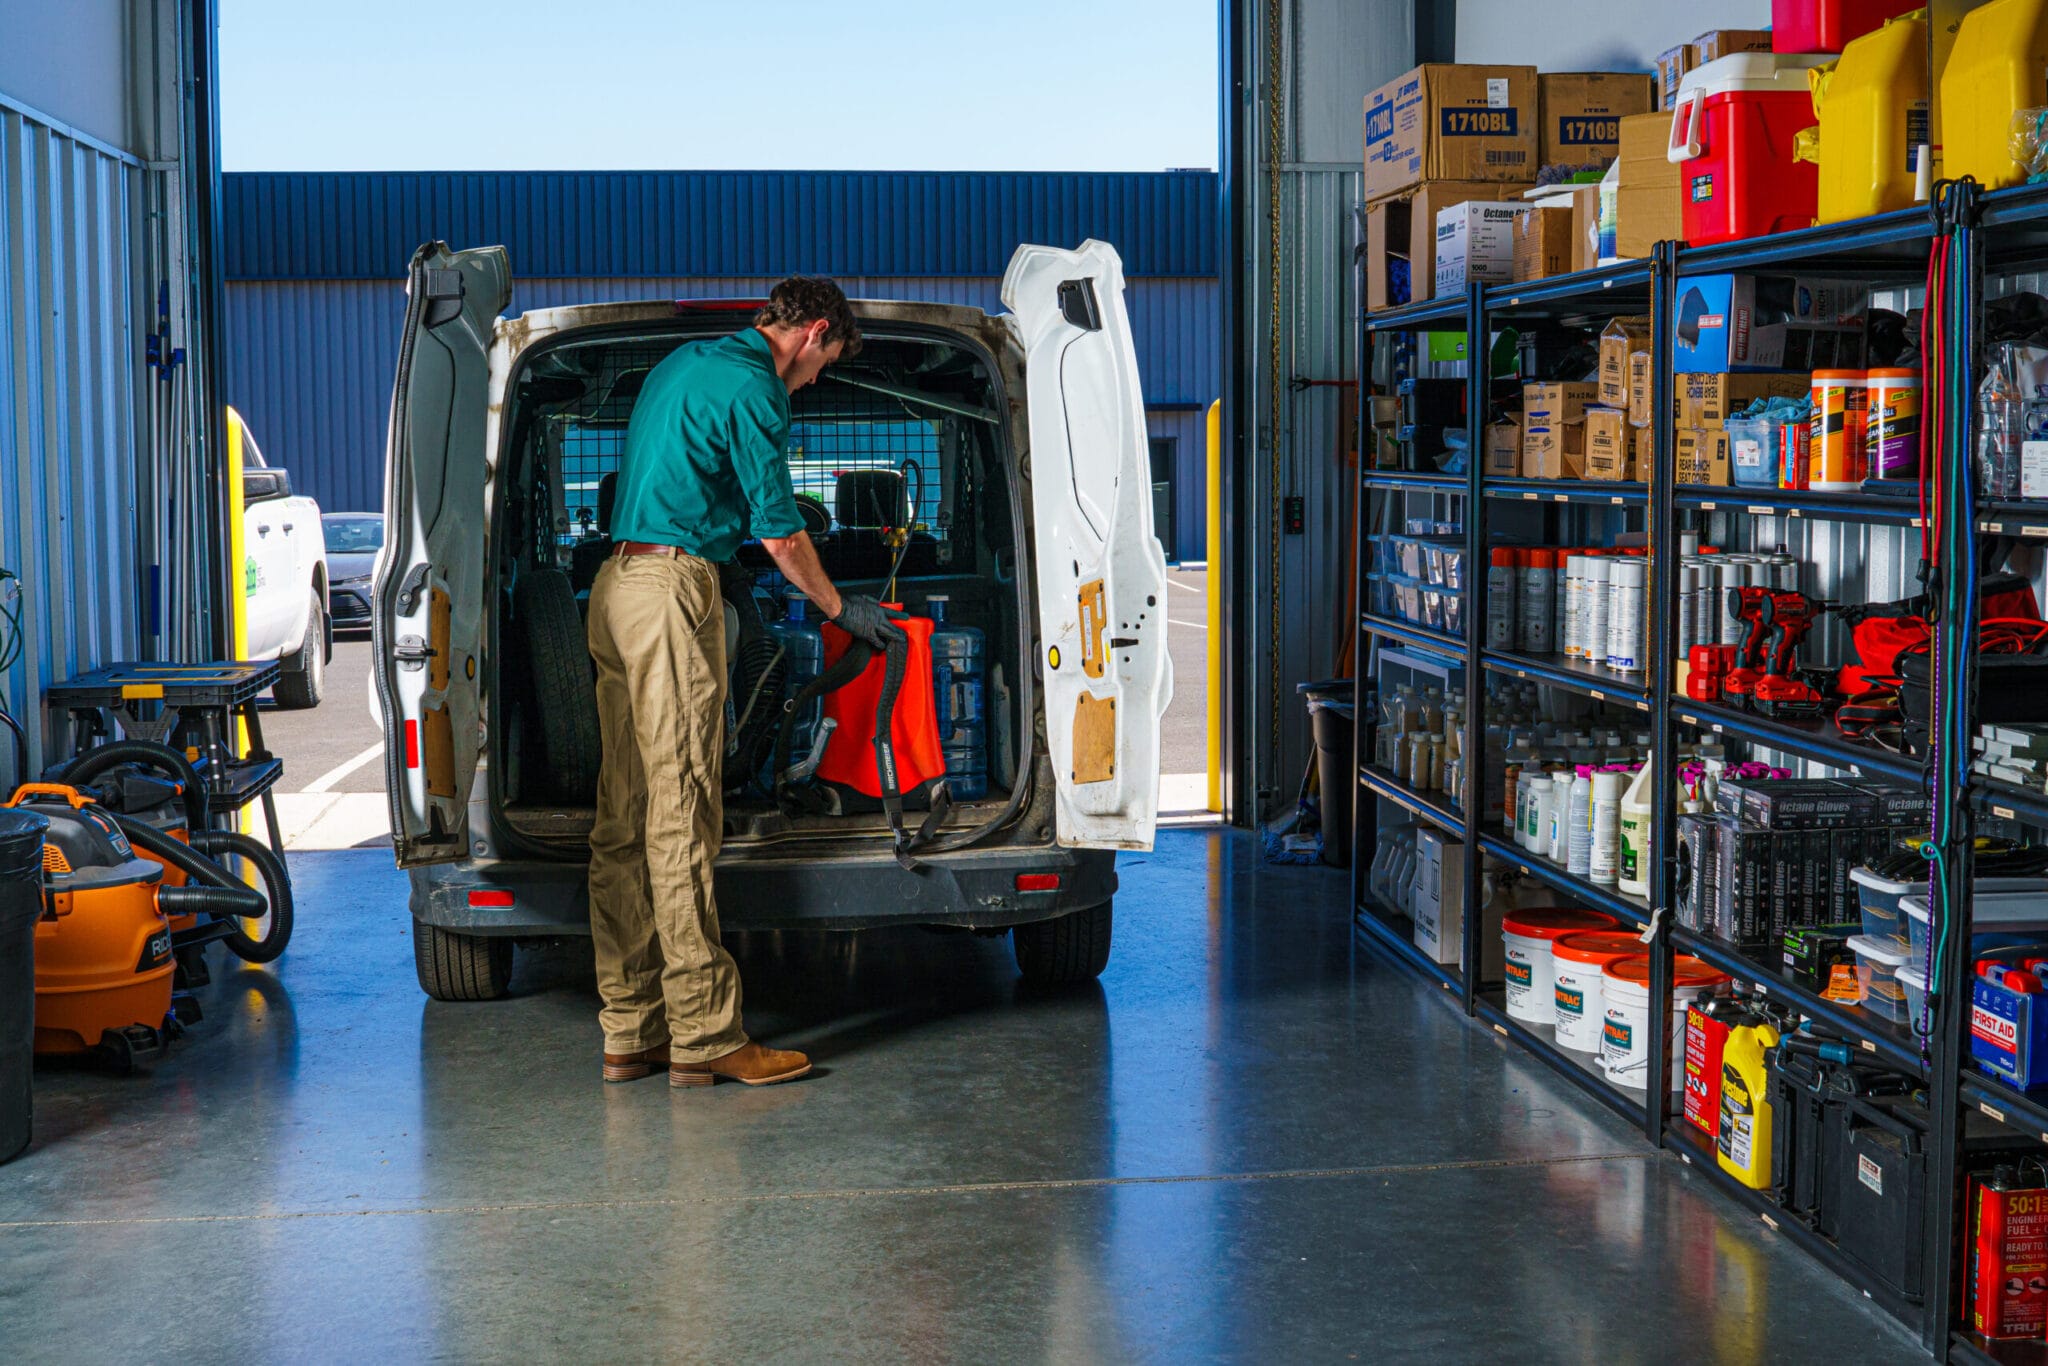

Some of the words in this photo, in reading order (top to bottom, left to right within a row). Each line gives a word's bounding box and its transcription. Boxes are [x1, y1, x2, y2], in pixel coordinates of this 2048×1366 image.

[1449, 112, 1511, 132] 1710BL
[1566, 122, 1617, 140] 1710B
[1483, 208, 1514, 219] Octane
[1779, 800, 1815, 812] Octane
[1816, 800, 1850, 812] Gloves
[1888, 798, 1924, 810] Octane
[1704, 850, 1714, 885] Gloves
[1743, 860, 1754, 897] Gloves
[1773, 860, 1785, 896] Gloves
[1802, 859, 1813, 895] Gloves
[1833, 858, 1844, 893] Gloves
[1704, 887, 1713, 924] Octane
[1743, 898, 1754, 936] Octane
[1773, 898, 1784, 935] Octane
[1802, 897, 1813, 925] ctane
[1833, 896, 1844, 923] ctane
[1975, 1011, 1997, 1033] FIRST
[1998, 1022, 2014, 1039] AID
[2008, 1196, 2040, 1214] 50:1
[2007, 1225, 2030, 1235] FUEL
[2007, 1242, 2032, 1252] READY
[2033, 1241, 2043, 1250] TO
